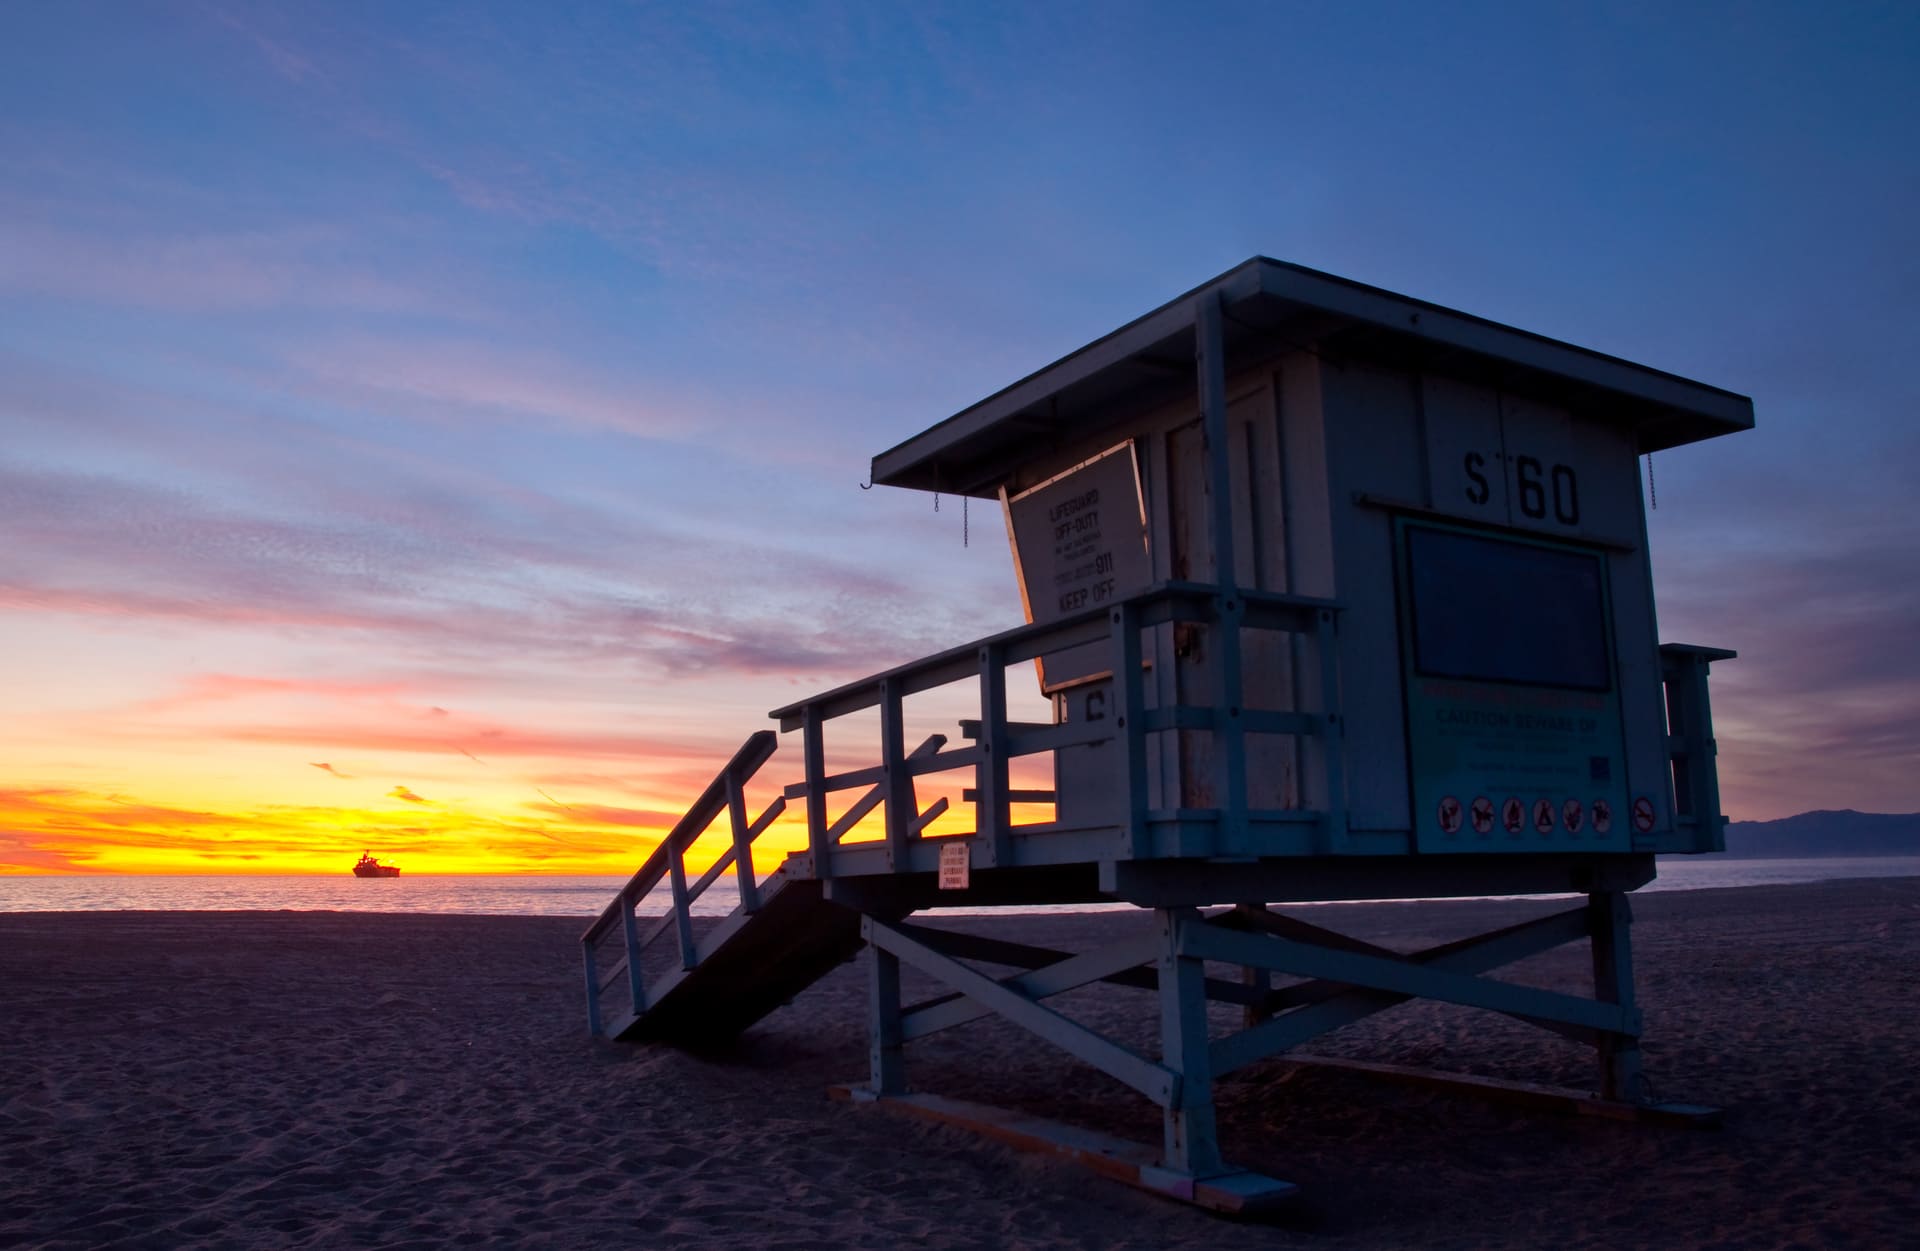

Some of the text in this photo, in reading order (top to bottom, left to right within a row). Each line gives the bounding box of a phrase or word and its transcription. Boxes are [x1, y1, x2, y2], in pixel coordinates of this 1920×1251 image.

[1464, 451, 1579, 526] S 60
[1049, 489, 1100, 522] LIFEGUARD
[1055, 511, 1099, 540] OFF-DUTY
[1095, 551, 1113, 575] 911
[1058, 578, 1116, 613] KEEP OFF
[1435, 707, 1510, 729] CAUTION
